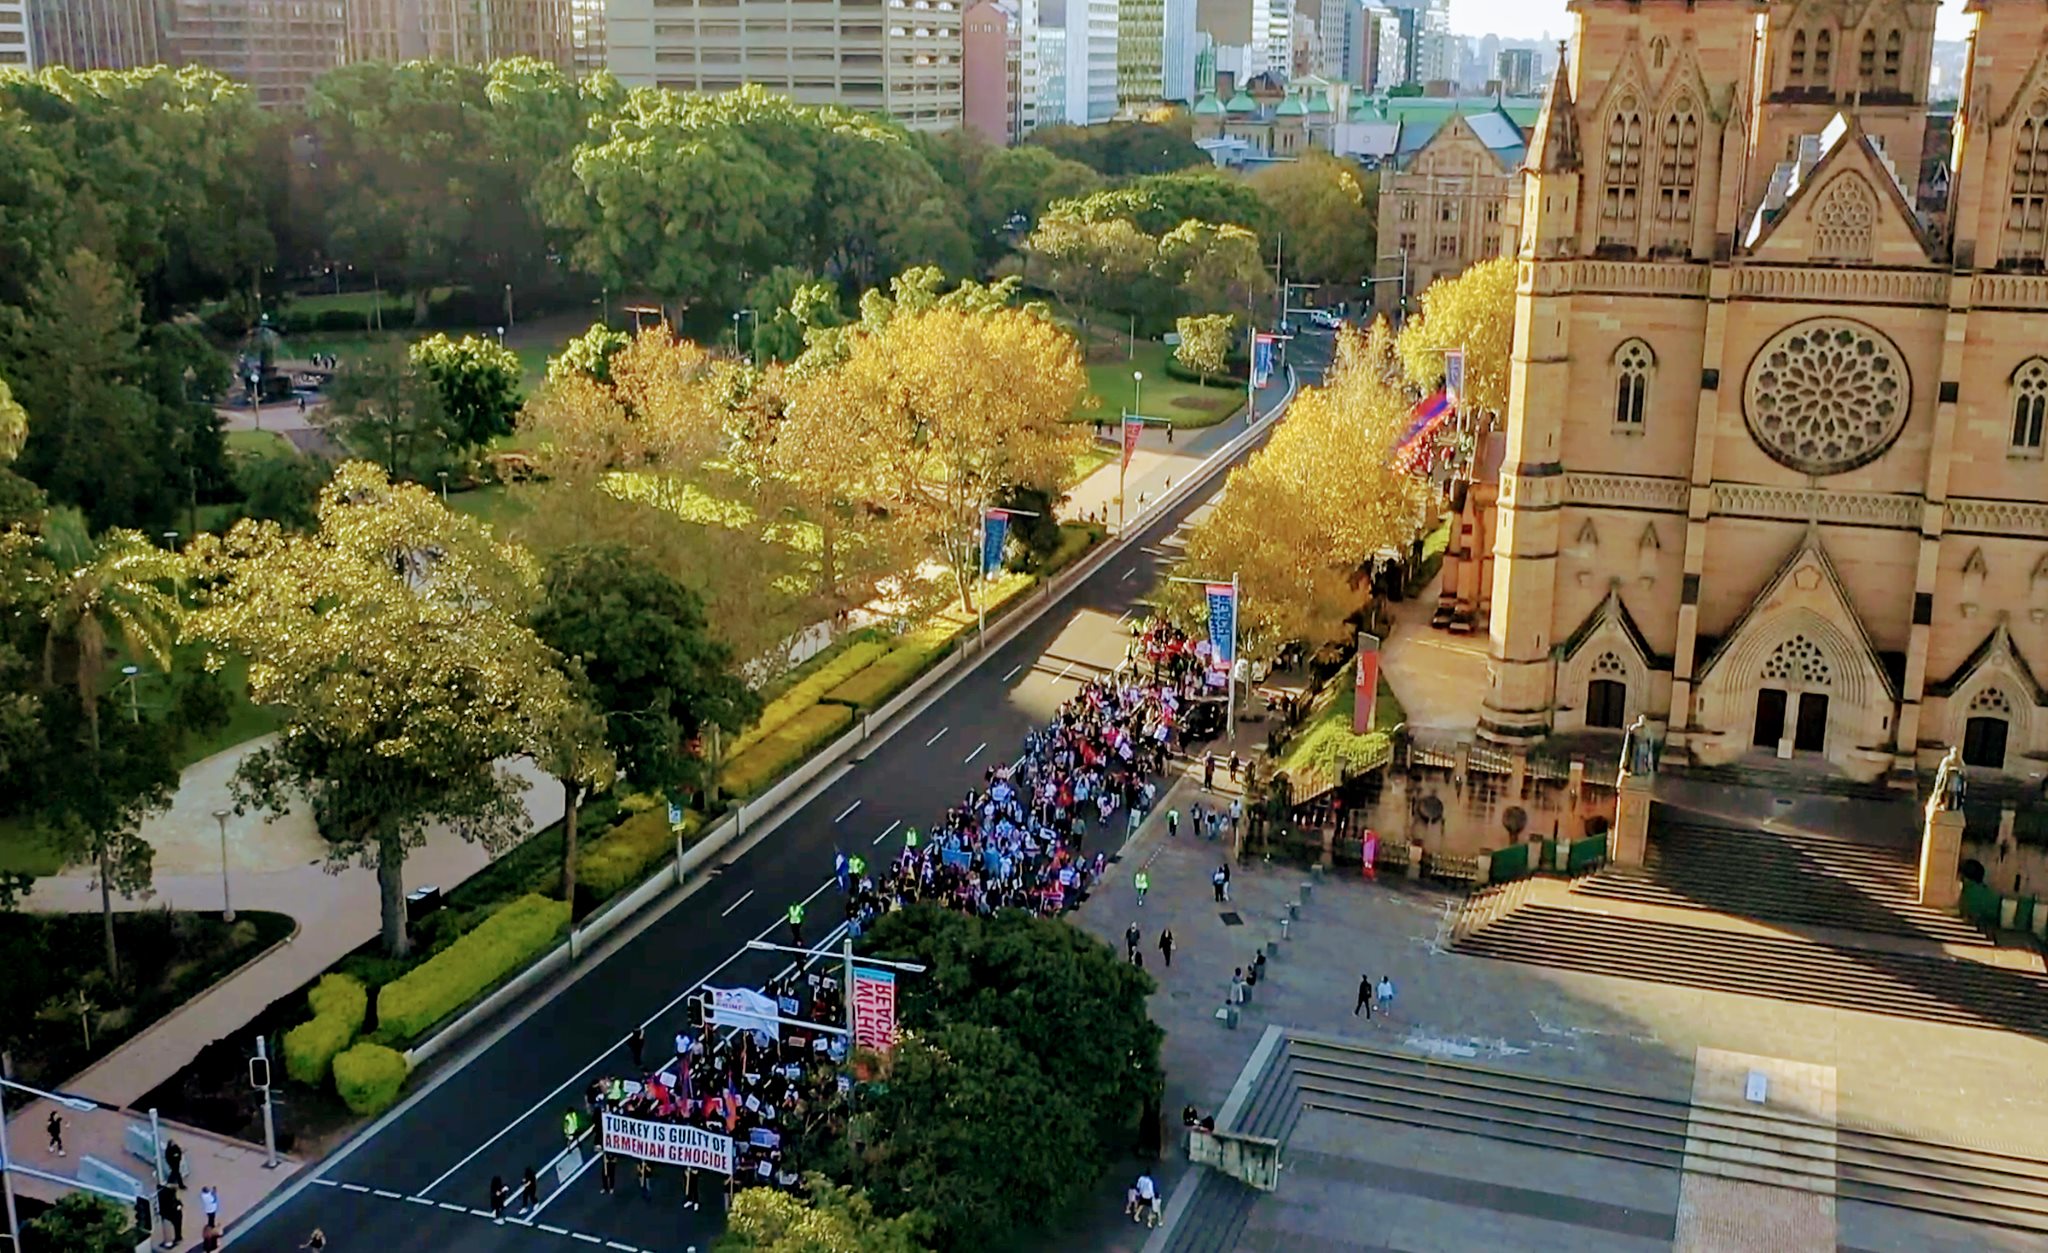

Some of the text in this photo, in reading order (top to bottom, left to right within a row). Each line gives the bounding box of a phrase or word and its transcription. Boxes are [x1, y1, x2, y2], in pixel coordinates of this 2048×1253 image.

[605, 1133, 727, 1170] ARMENIAN GENOCIDE
[606, 1116, 726, 1153] TURKEY IS GUILTY OF
